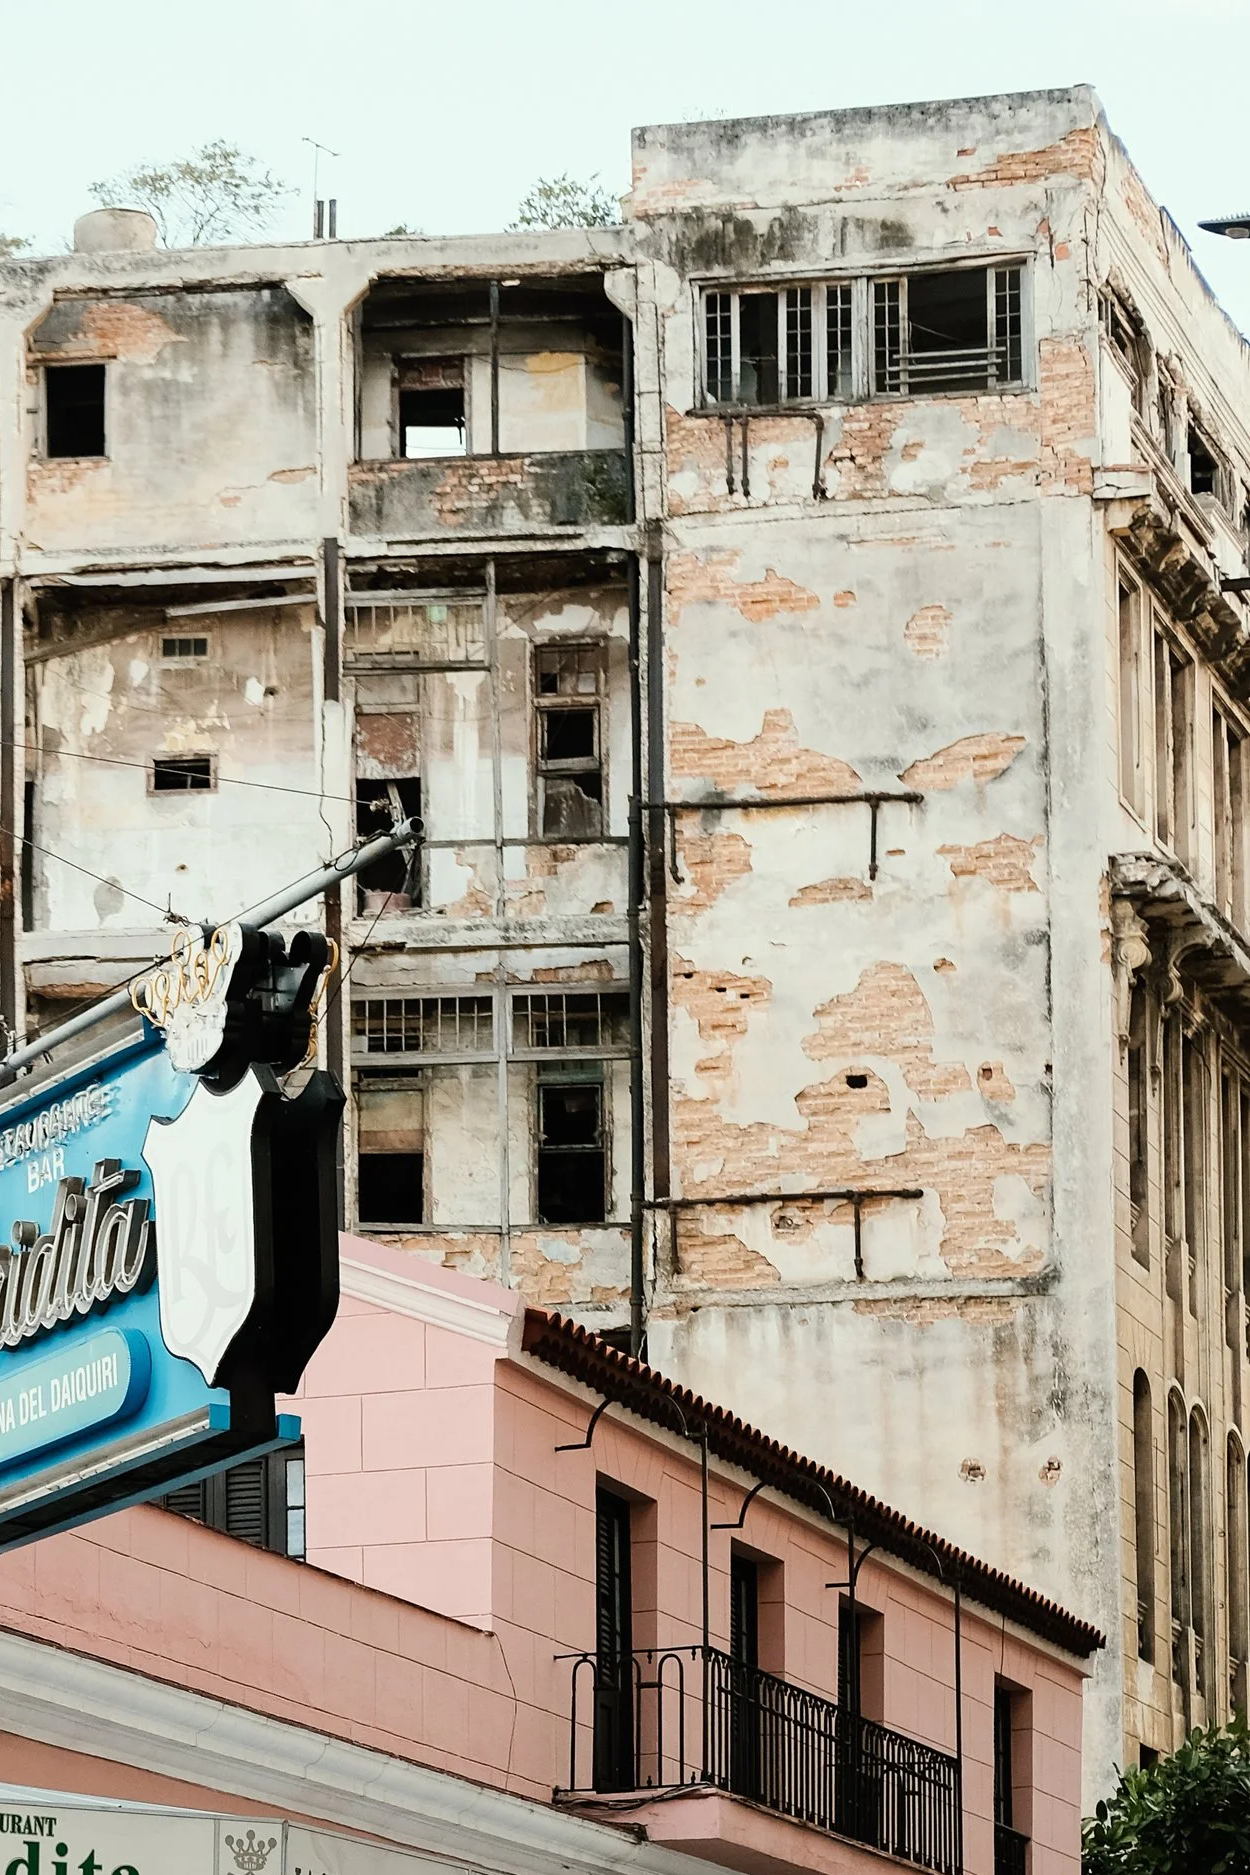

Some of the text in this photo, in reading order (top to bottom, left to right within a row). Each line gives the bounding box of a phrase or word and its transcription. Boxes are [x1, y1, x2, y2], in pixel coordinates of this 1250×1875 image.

[27, 1148, 65, 1193] BAR
[19, 1385, 47, 1425] DEL
[50, 1353, 118, 1408] DAIQUIRI
